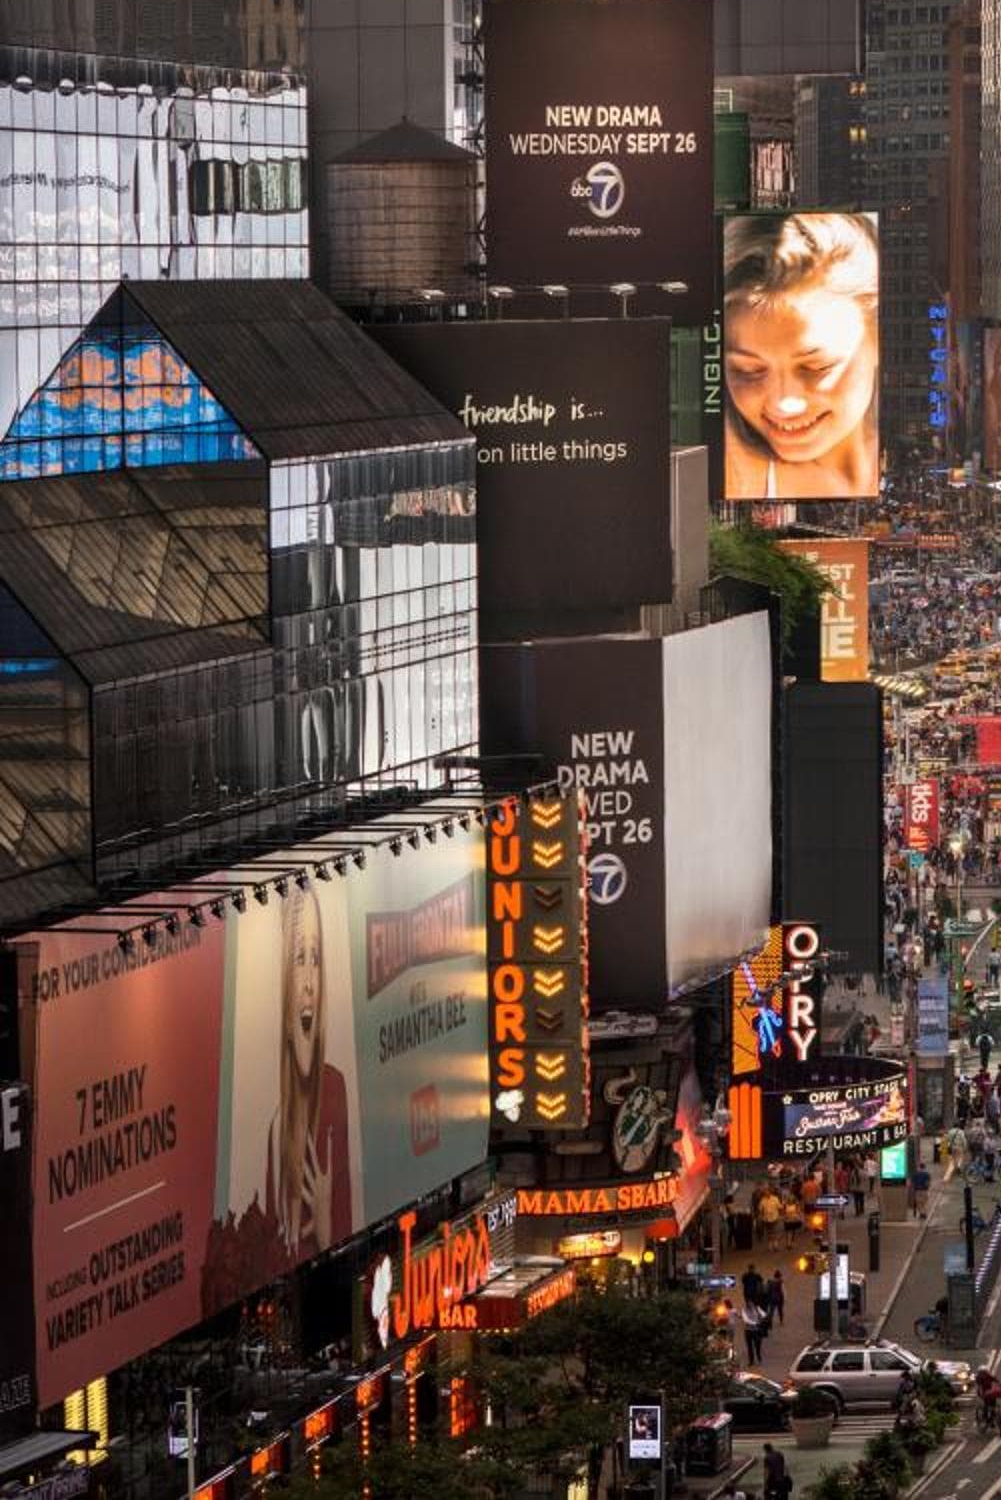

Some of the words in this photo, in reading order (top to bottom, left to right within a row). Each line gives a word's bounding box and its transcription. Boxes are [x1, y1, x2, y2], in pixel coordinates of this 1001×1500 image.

[545, 105, 592, 128] NEW
[596, 104, 663, 127] DRAMA
[509, 133, 623, 156] WEDNESDAY
[626, 132, 671, 154] SEPT
[675, 132, 698, 154] 26
[458, 394, 557, 427] friendship
[477, 446, 504, 464] on
[510, 442, 557, 463] little
[562, 439, 628, 462] things
[570, 730, 636, 760] NEW
[557, 759, 650, 789] DRAMA
[911, 783, 933, 823] tkts
[622, 817, 653, 845] 26
[491, 796, 526, 1088] JUNIORS
[31, 966, 60, 1005] FOR
[62, 952, 99, 994] YOUR
[788, 926, 819, 1062] OPRY
[378, 999, 444, 1065] SAMANTHA
[446, 994, 467, 1031] BEE
[76, 1089, 87, 1136] 7
[92, 1063, 147, 1129] EMMY
[808, 1091, 839, 1104] OPRY
[845, 1086, 871, 1100] CITY
[1, 1086, 22, 1152] E
[48, 1103, 177, 1205] NOMINATIONS
[782, 1131, 878, 1155] RESTAURANT
[517, 1188, 612, 1215] MAMA
[616, 1174, 681, 1211] SBARR
[89, 1209, 183, 1286] OUTSTANDING
[46, 1287, 104, 1351] VARIETY
[106, 1273, 140, 1319] TALK
[142, 1251, 185, 1301] SERIES
[438, 1304, 478, 1328] BAR
